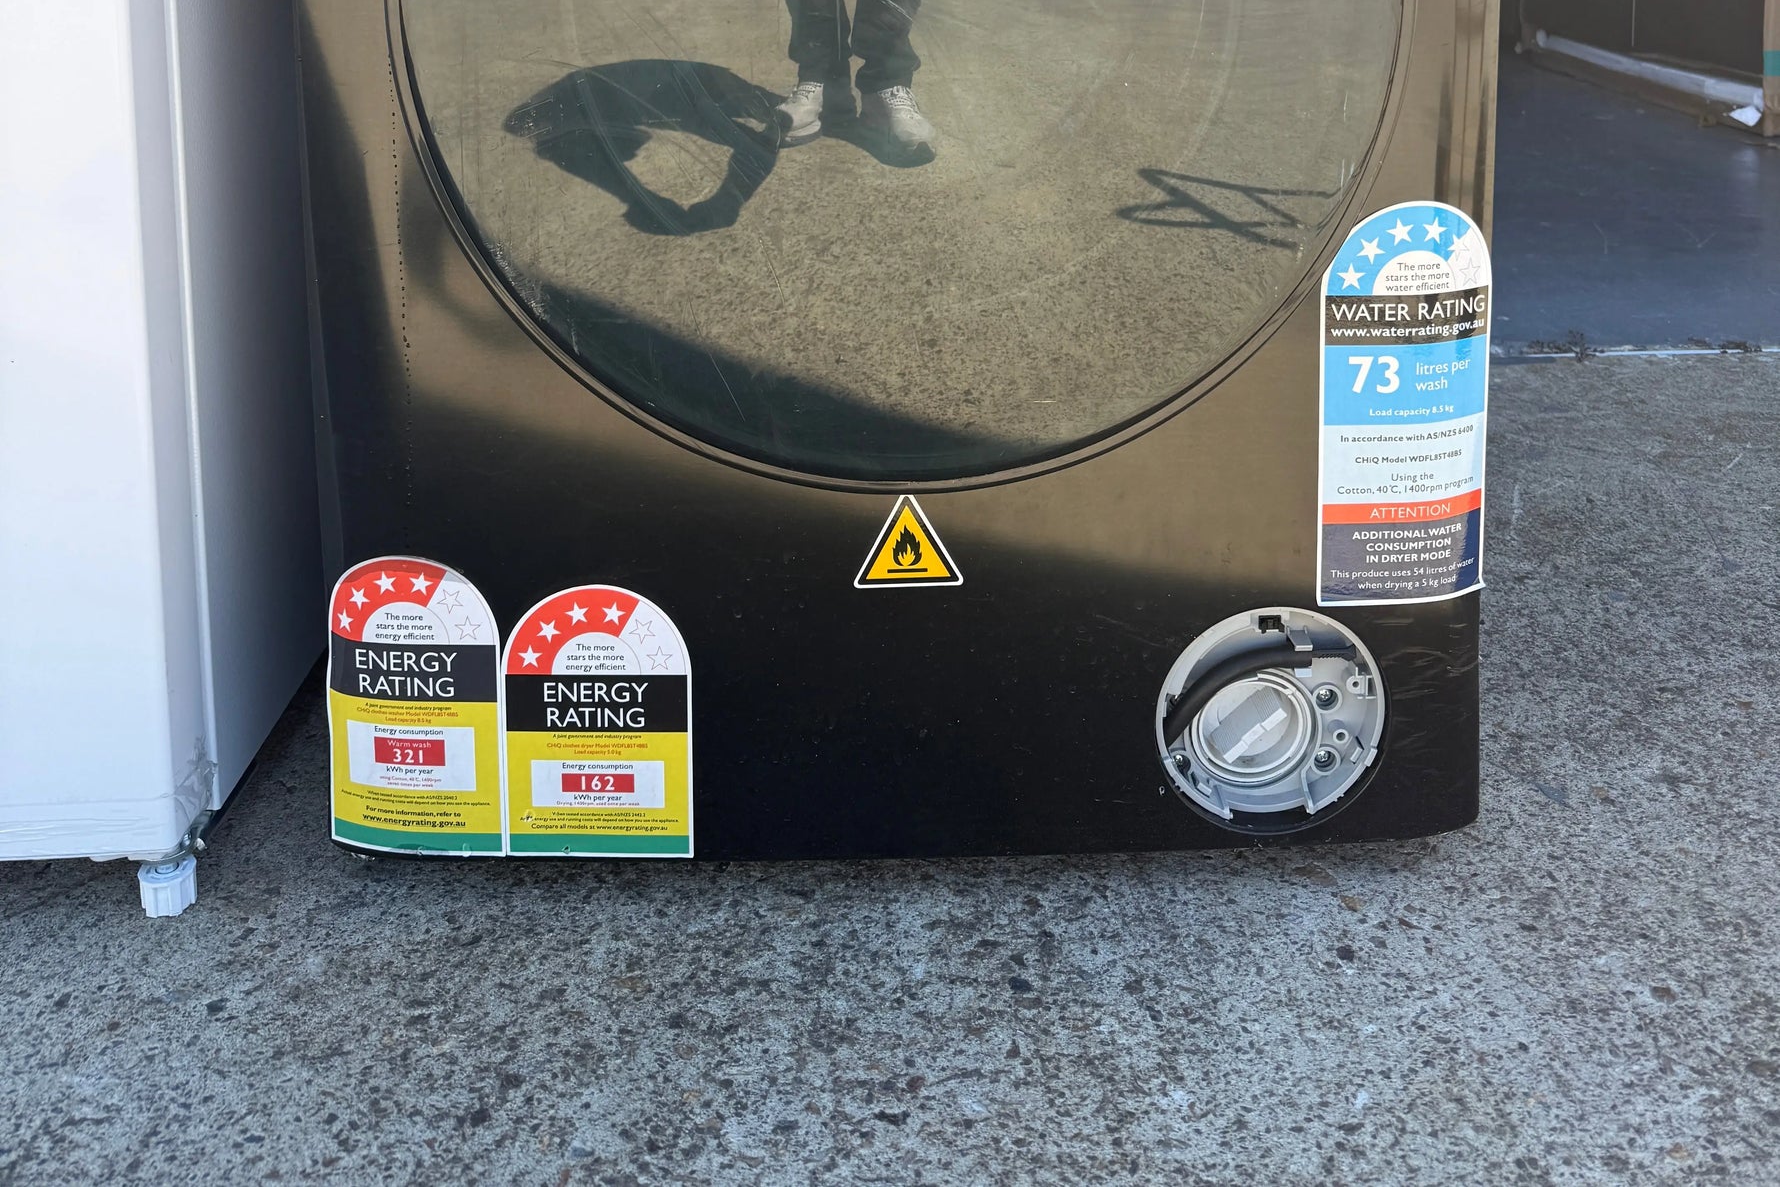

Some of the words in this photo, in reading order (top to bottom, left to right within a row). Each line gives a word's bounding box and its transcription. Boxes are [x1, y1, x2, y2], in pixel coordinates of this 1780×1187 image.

[1397, 263, 1416, 271] The
[1411, 273, 1426, 281] the
[1416, 282, 1449, 291] efficient
[1331, 304, 1410, 322] WATER
[1418, 295, 1485, 320] RATING
[1331, 318, 1484, 337] www.waterrating.gov.au
[1416, 362, 1448, 375] litres
[1451, 358, 1471, 374] per
[1349, 356, 1400, 394] 73
[1416, 377, 1448, 391] wash
[1394, 408, 1430, 417] capacity
[1426, 429, 1456, 440] AS/NZS
[1458, 425, 1473, 434] 6400
[1355, 456, 1379, 464] CHiQ
[1338, 486, 1375, 495] Cotton,
[1405, 484, 1442, 494] 1400rpm
[1445, 476, 1473, 490] program
[1391, 474, 1417, 483] Using
[1370, 503, 1450, 519] ATTENTION
[1352, 531, 1427, 540] ADDITIONAL
[1429, 523, 1461, 537] WATER
[1366, 538, 1451, 551] CONSUMPTION
[1366, 555, 1379, 563] IN
[1382, 553, 1417, 563] DRYER
[1421, 550, 1451, 561] MODE
[1331, 570, 1349, 578] This
[1352, 570, 1389, 579] produce
[1392, 569, 1411, 577] uses
[1413, 568, 1423, 576] 54
[1426, 566, 1447, 575] litres
[1449, 562, 1457, 571] of
[1457, 557, 1474, 568] water
[1358, 581, 1381, 589] when
[1385, 580, 1413, 590] drying
[1422, 578, 1427, 586] 5
[1429, 578, 1438, 587] kg
[1441, 574, 1456, 584] load
[385, 613, 400, 621] The
[376, 633, 400, 641] energy
[403, 632, 434, 640] efficient
[355, 649, 457, 672] ENERGY
[566, 664, 592, 672] energy
[595, 663, 626, 671] efficient
[359, 674, 454, 697] RATING
[543, 682, 648, 703] ENERGY
[547, 708, 645, 727] RATING
[375, 726, 397, 735] Energy
[388, 740, 410, 748] Warm
[393, 748, 423, 763] 321
[588, 763, 633, 771] consumption
[581, 775, 615, 791] 162
[378, 806, 394, 814] more
[396, 809, 435, 817] information,
[363, 813, 466, 828] www.energyrating.gov.au
